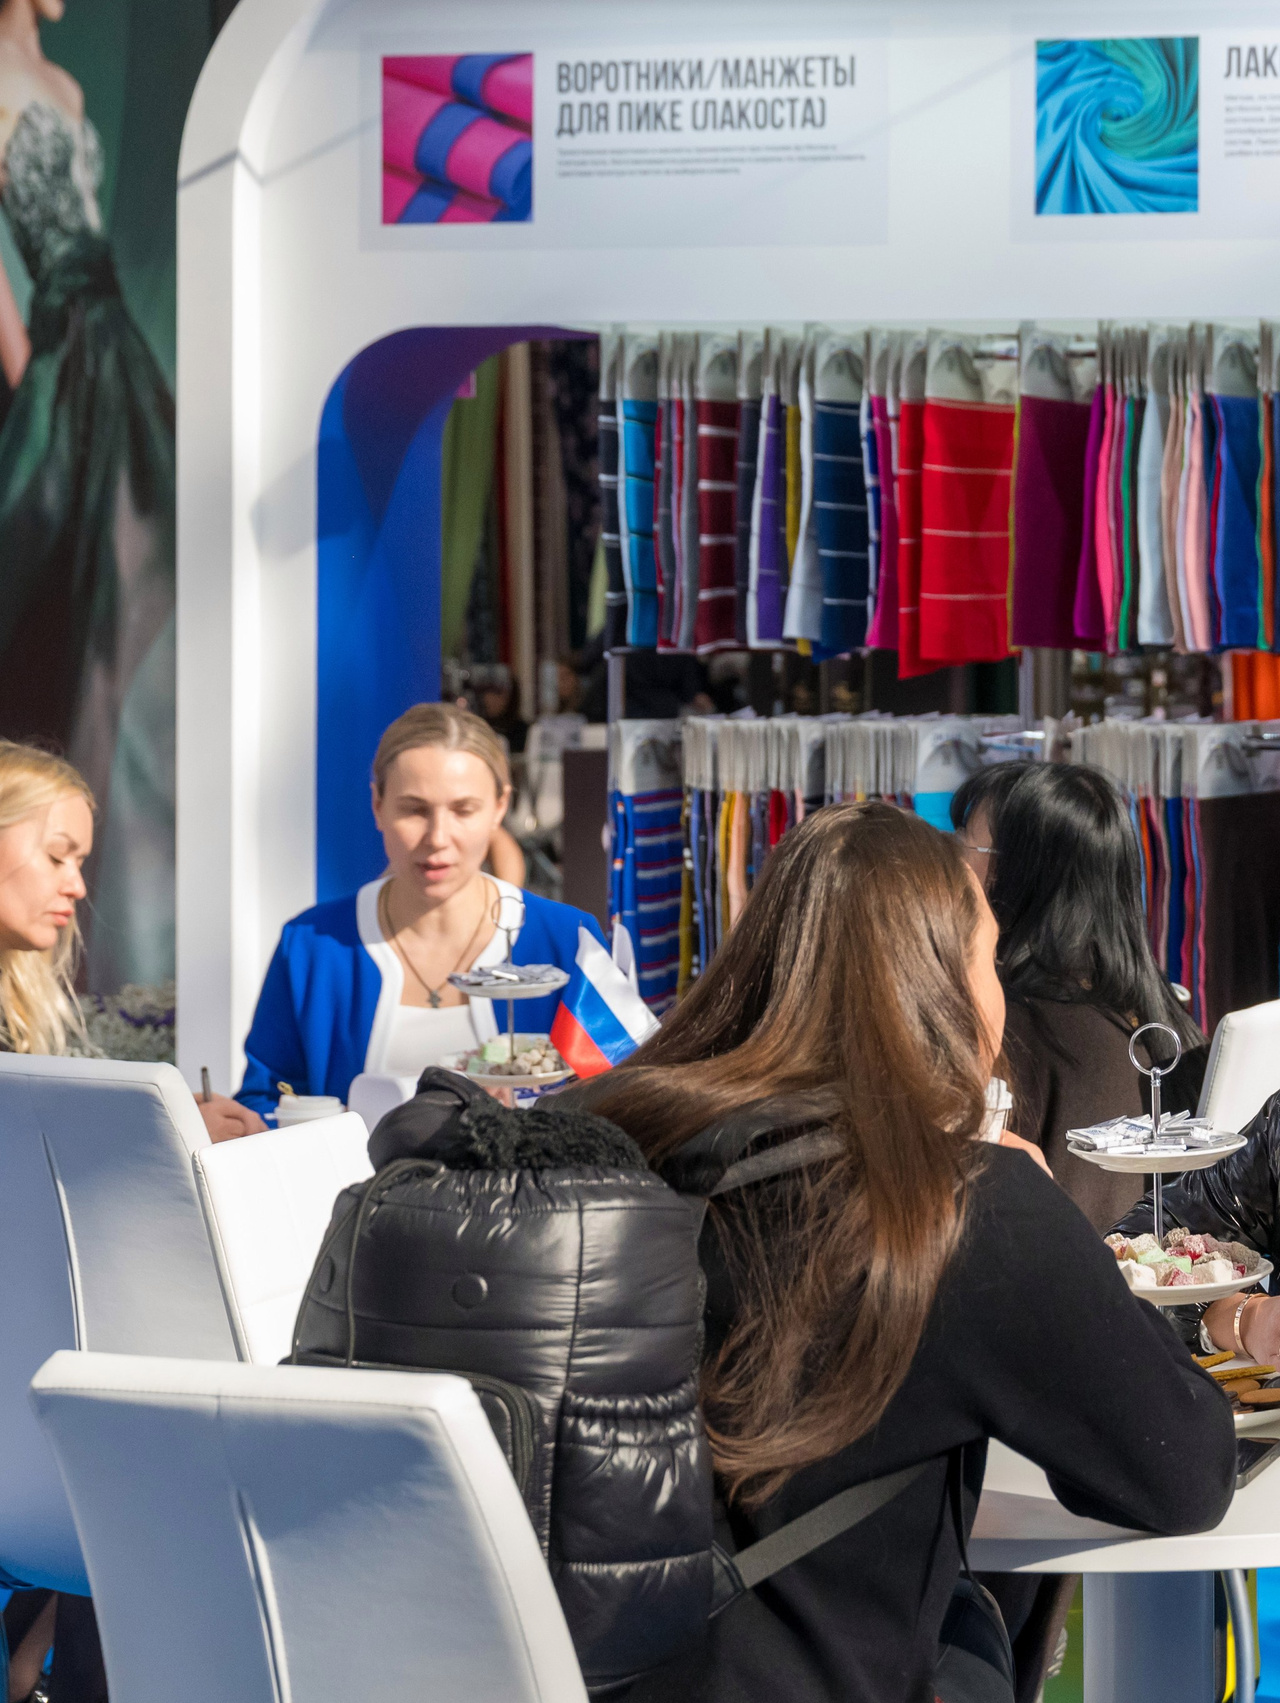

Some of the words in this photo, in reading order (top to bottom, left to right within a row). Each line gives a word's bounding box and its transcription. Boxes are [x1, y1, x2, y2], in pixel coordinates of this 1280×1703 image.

[556, 55, 856, 94] ВОРОТНИКИ/МАНЖЕТЫ
[556, 101, 609, 137] ДЛЯ
[618, 99, 683, 132] ПИКЕ
[692, 96, 826, 131] (ЛАКОСТА)
